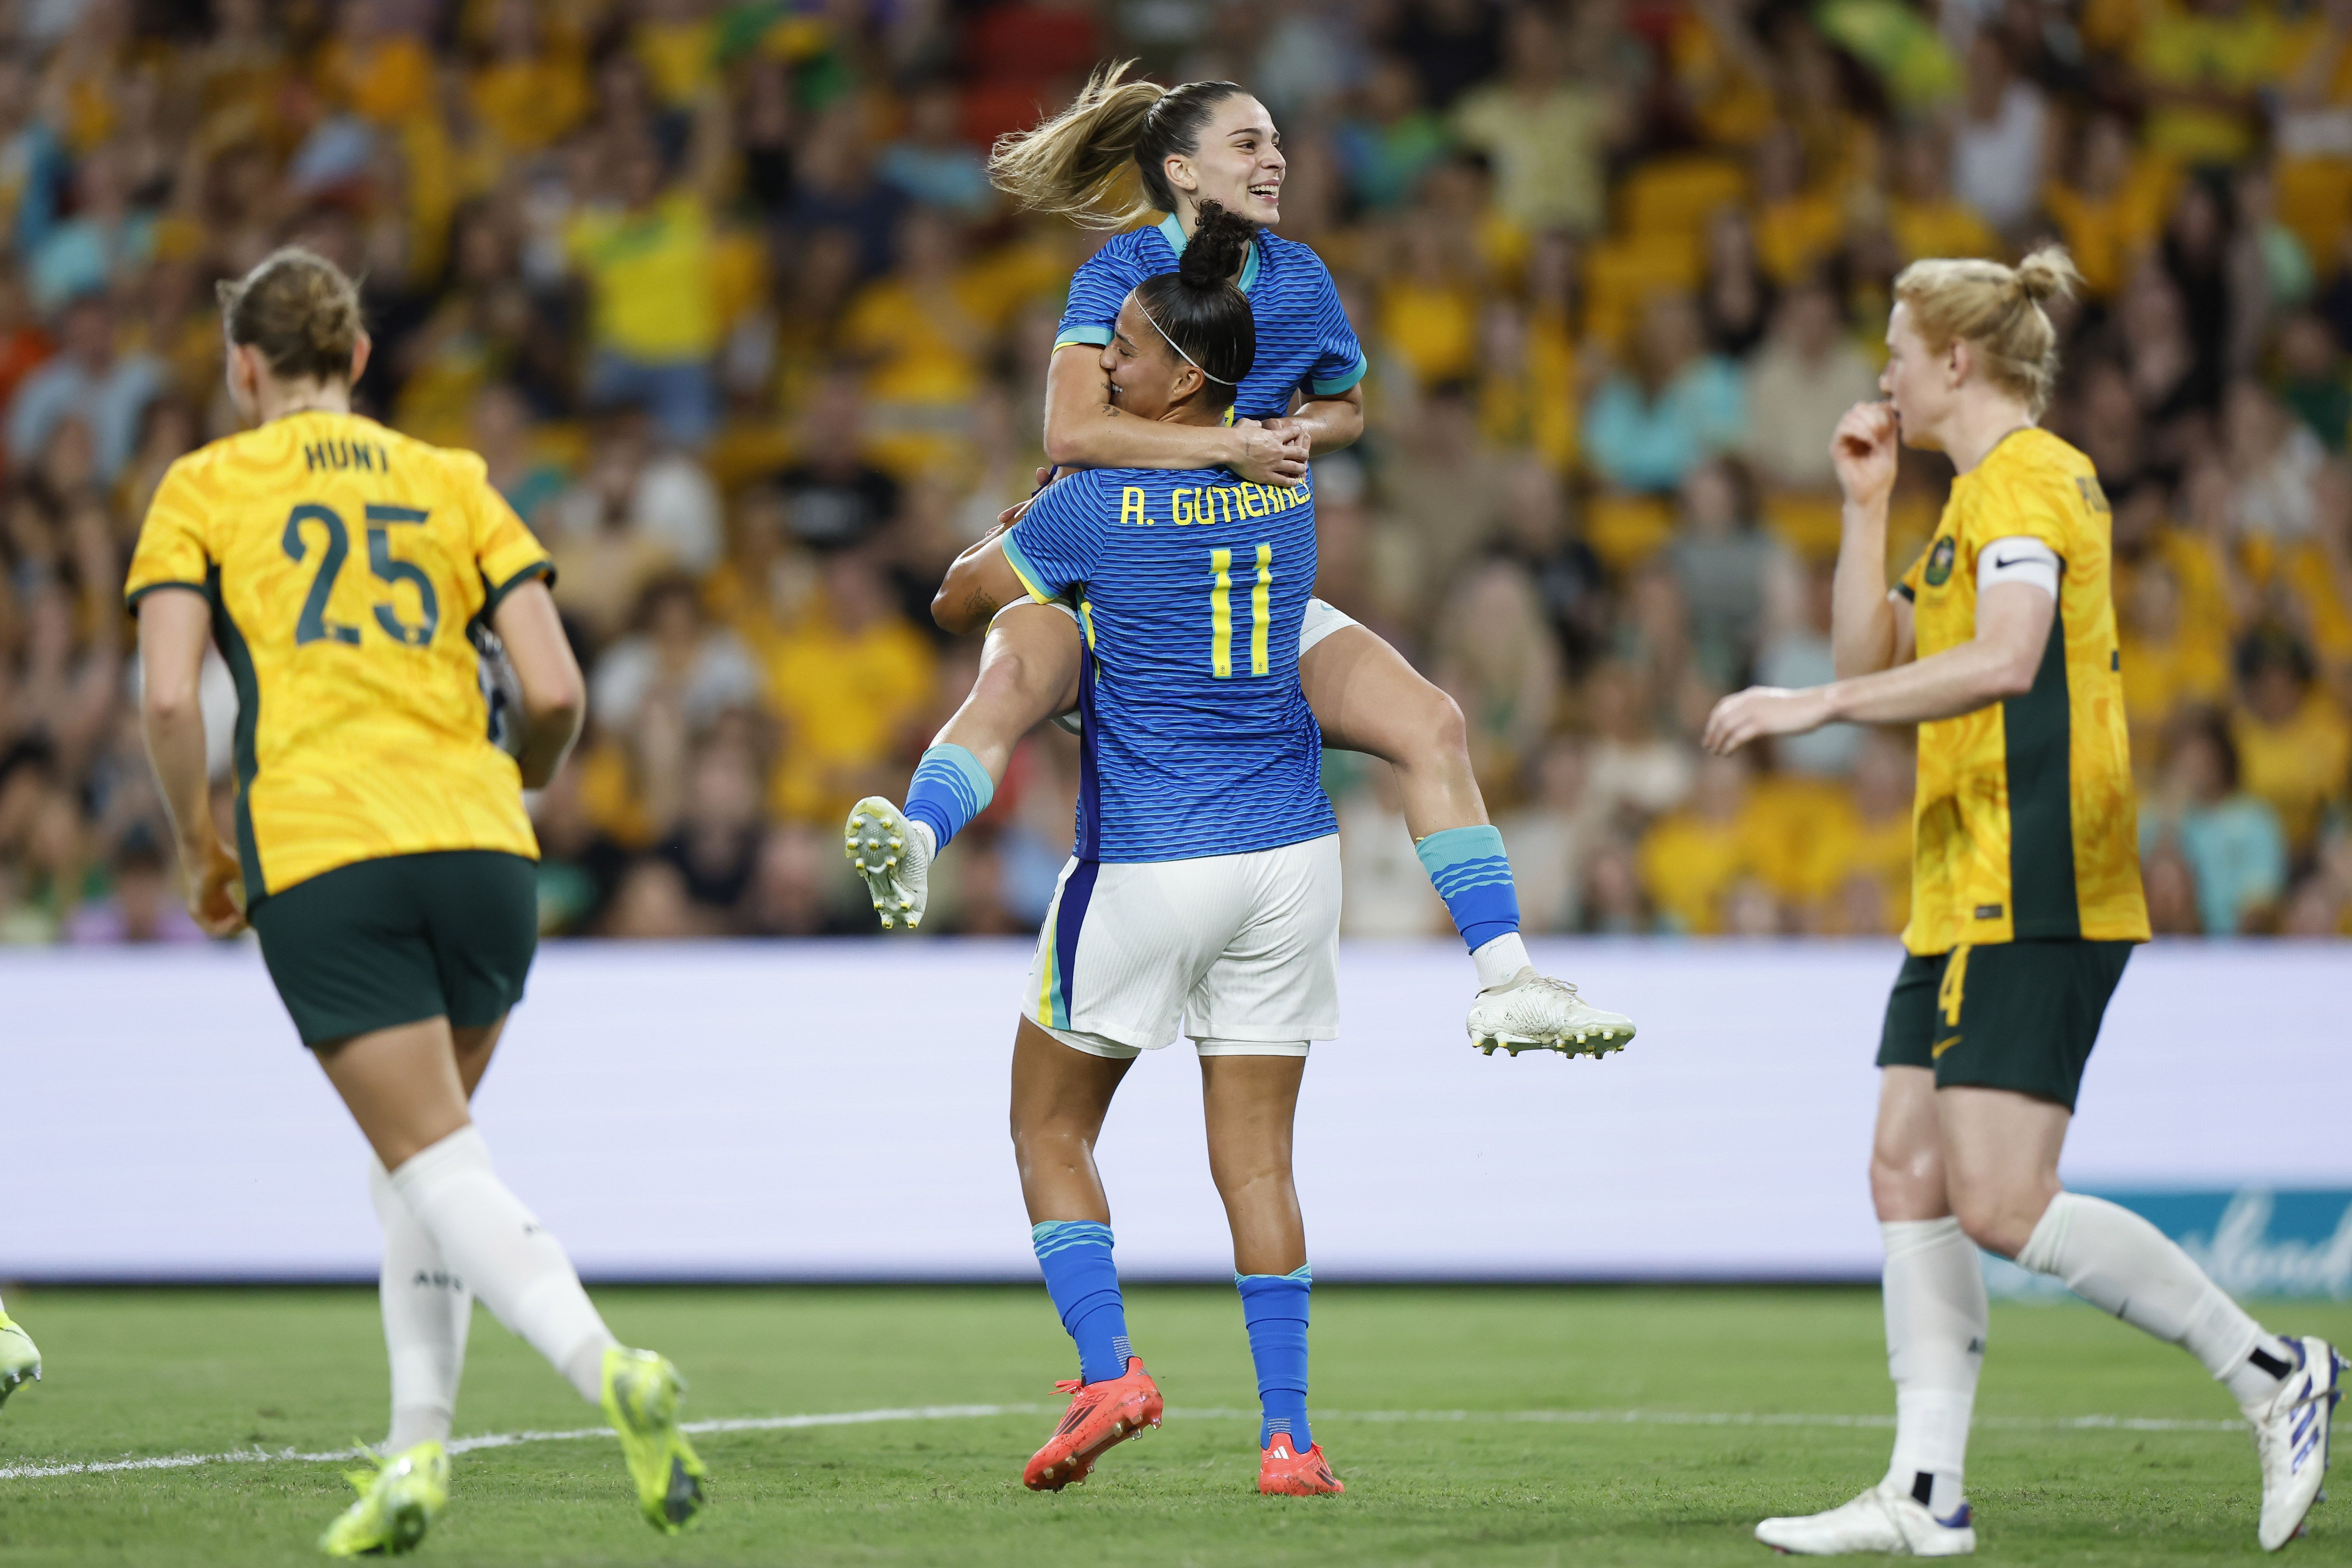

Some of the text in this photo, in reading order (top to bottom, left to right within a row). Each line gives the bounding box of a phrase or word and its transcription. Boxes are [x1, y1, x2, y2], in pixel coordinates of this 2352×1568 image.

[1120, 486, 1154, 526] A.
[283, 502, 439, 648] 25
[1208, 542, 1272, 679] 11
[1938, 943, 1967, 1026] 4
